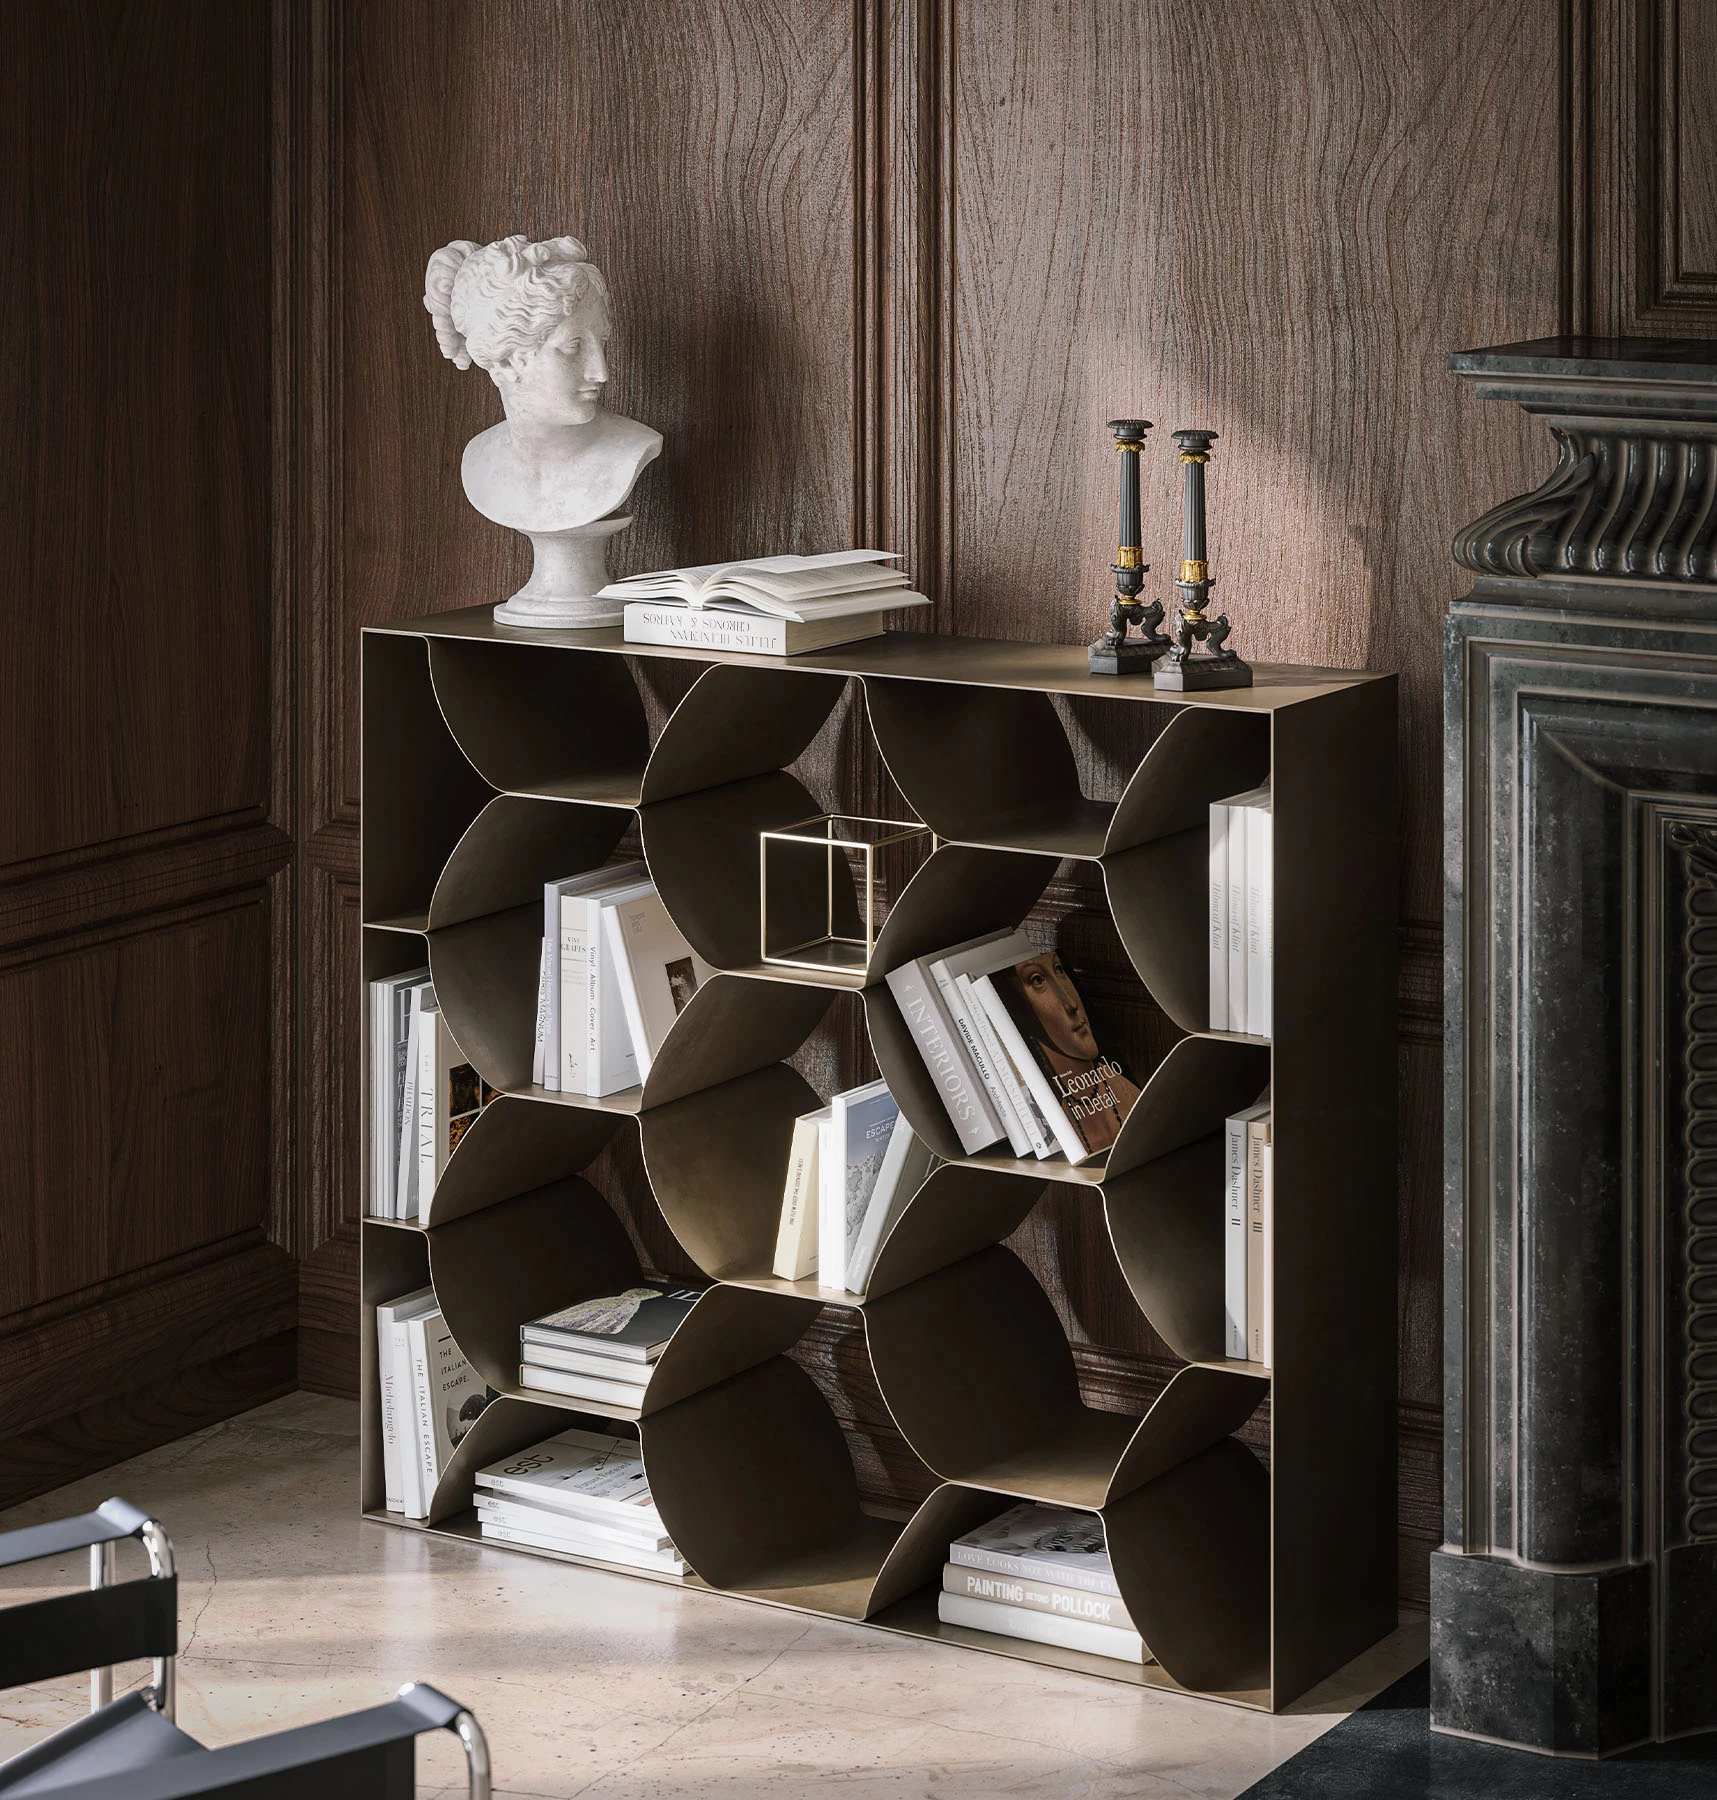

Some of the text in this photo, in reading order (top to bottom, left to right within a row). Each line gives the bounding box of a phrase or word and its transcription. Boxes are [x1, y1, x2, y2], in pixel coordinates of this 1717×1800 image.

[643, 612, 683, 627] KAIROS
[702, 618, 750, 632] CHRONOS
[736, 634, 777, 649] JULIUS
[537, 999, 546, 1043] MAGNUM
[907, 997, 976, 1121] INTERIORS
[958, 1018, 973, 1047] DAVIDE
[970, 1045, 990, 1081] MACULLO
[1052, 1055, 1123, 1098] Leonardo
[404, 1081, 414, 1126] PHAIDON
[1067, 1085, 1121, 1121] in Detail
[420, 1088, 433, 1164] TRIAL
[1230, 1131, 1241, 1226] James Dashner II
[1252, 1135, 1263, 1233] James Dashner III
[416, 1359, 424, 1378] THE
[440, 1347, 452, 1361] THE
[441, 1359, 468, 1376] ITALIAN
[384, 1374, 397, 1446] Michelangelo
[418, 1385, 429, 1427] ITALIAN
[490, 1479, 505, 1488] est
[504, 1454, 555, 1476] est
[497, 1529, 512, 1538] est
[957, 1550, 983, 1565] LOVE
[986, 1557, 1019, 1572] LOOKS
[967, 1575, 1024, 1603] PAINTING
[1052, 1591, 1112, 1621] POLLOCK
